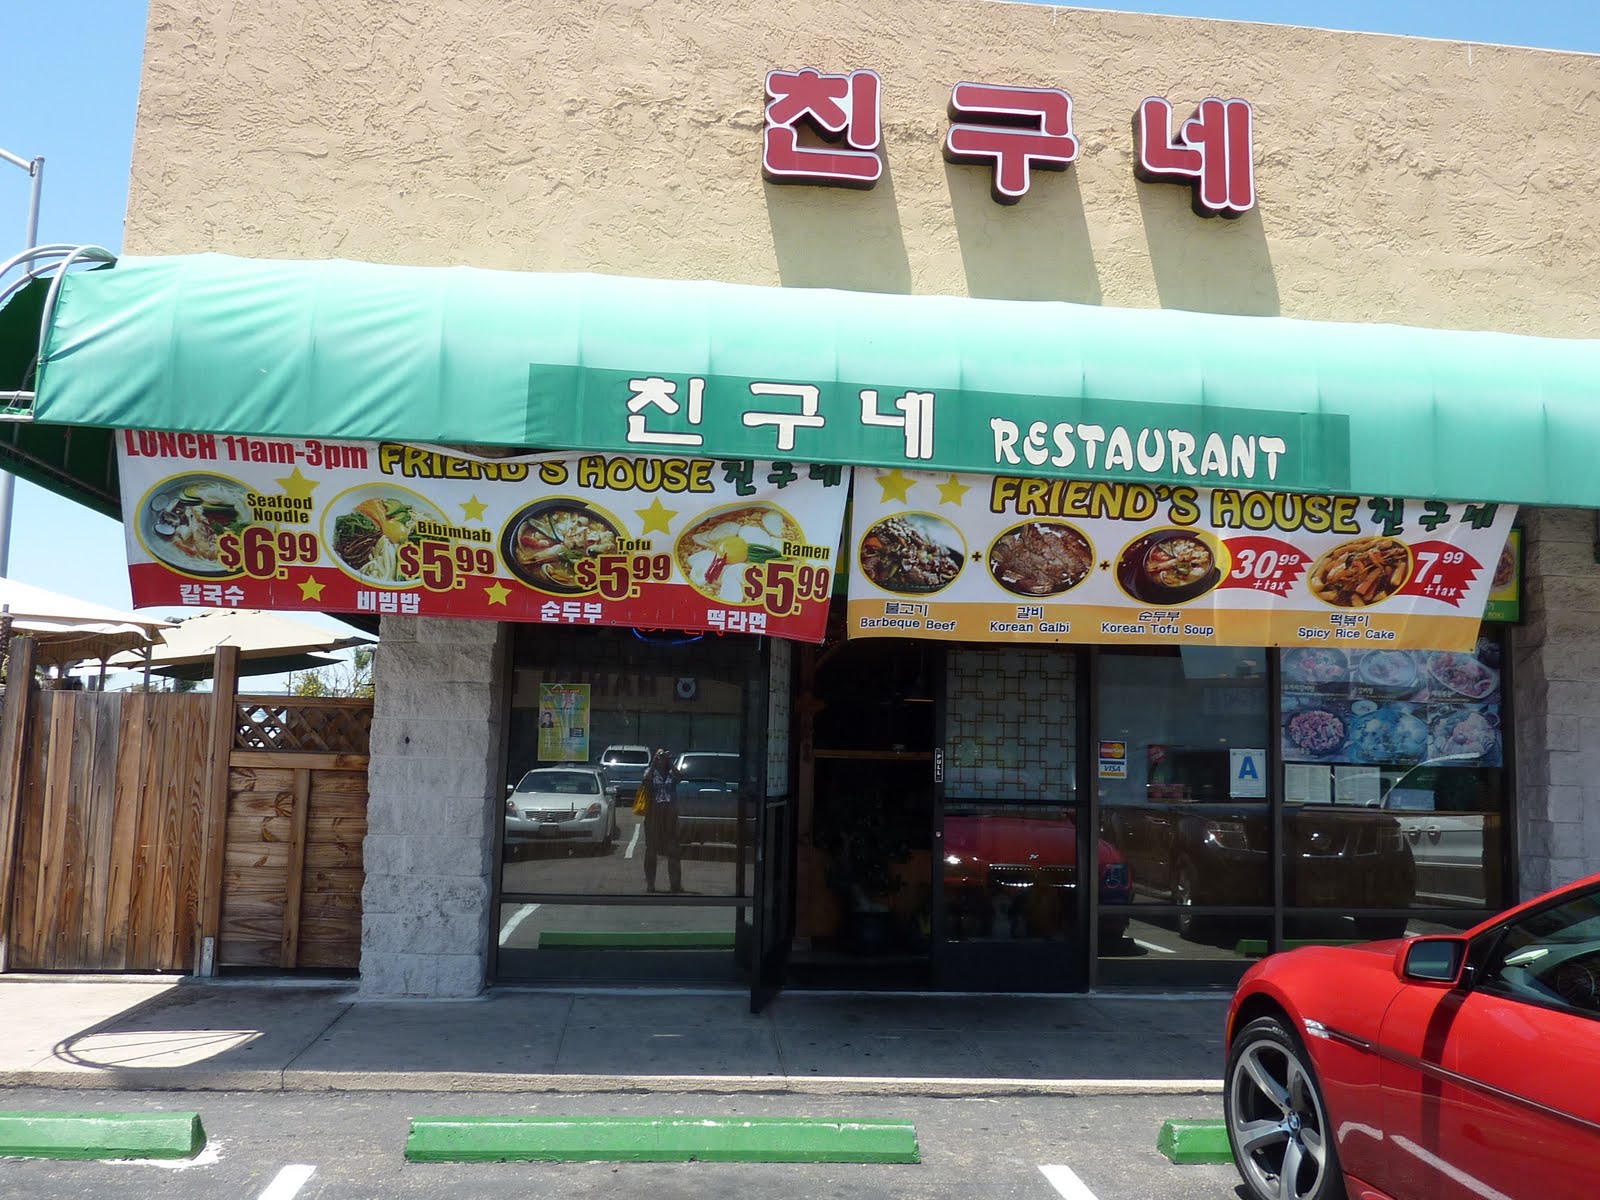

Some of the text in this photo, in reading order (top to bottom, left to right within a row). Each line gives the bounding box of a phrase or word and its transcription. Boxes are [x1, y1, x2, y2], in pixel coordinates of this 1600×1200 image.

[124, 429, 368, 470] LUNCH 11am-3pm
[989, 417, 1287, 481] RESTAURANT
[577, 455, 716, 493] HOUSE
[247, 493, 313, 511] Seafood
[988, 474, 1200, 526] FRIEND'S
[1210, 488, 1362, 534] HOUSE
[253, 507, 310, 524] Noodle
[418, 521, 492, 543] Bibimbab
[219, 527, 319, 579] $6.99
[617, 538, 651, 552] Tofu
[783, 541, 830, 560] Ramen
[399, 541, 496, 592] $5.99
[1231, 550, 1300, 579] 30.99
[1413, 551, 1464, 584] 7.99
[576, 554, 672, 602] $5.99
[744, 561, 830, 616] $5.99
[1253, 579, 1285, 591] +tax
[180, 584, 245, 607] 칼국수
[356, 590, 421, 613] 비빔밥
[1424, 584, 1457, 597] +tax
[541, 600, 602, 624] 순두부
[885, 602, 928, 617] 불고기
[1017, 606, 1044, 619] 갈비
[707, 609, 767, 634] 떡라면
[860, 617, 957, 632] Barbeque Beef
[990, 621, 1071, 633] Korean Galbi
[1101, 622, 1215, 637] Korean Tofu Soup
[1298, 627, 1396, 640] Spicy Rice Cake
[1238, 756, 1258, 779] A
